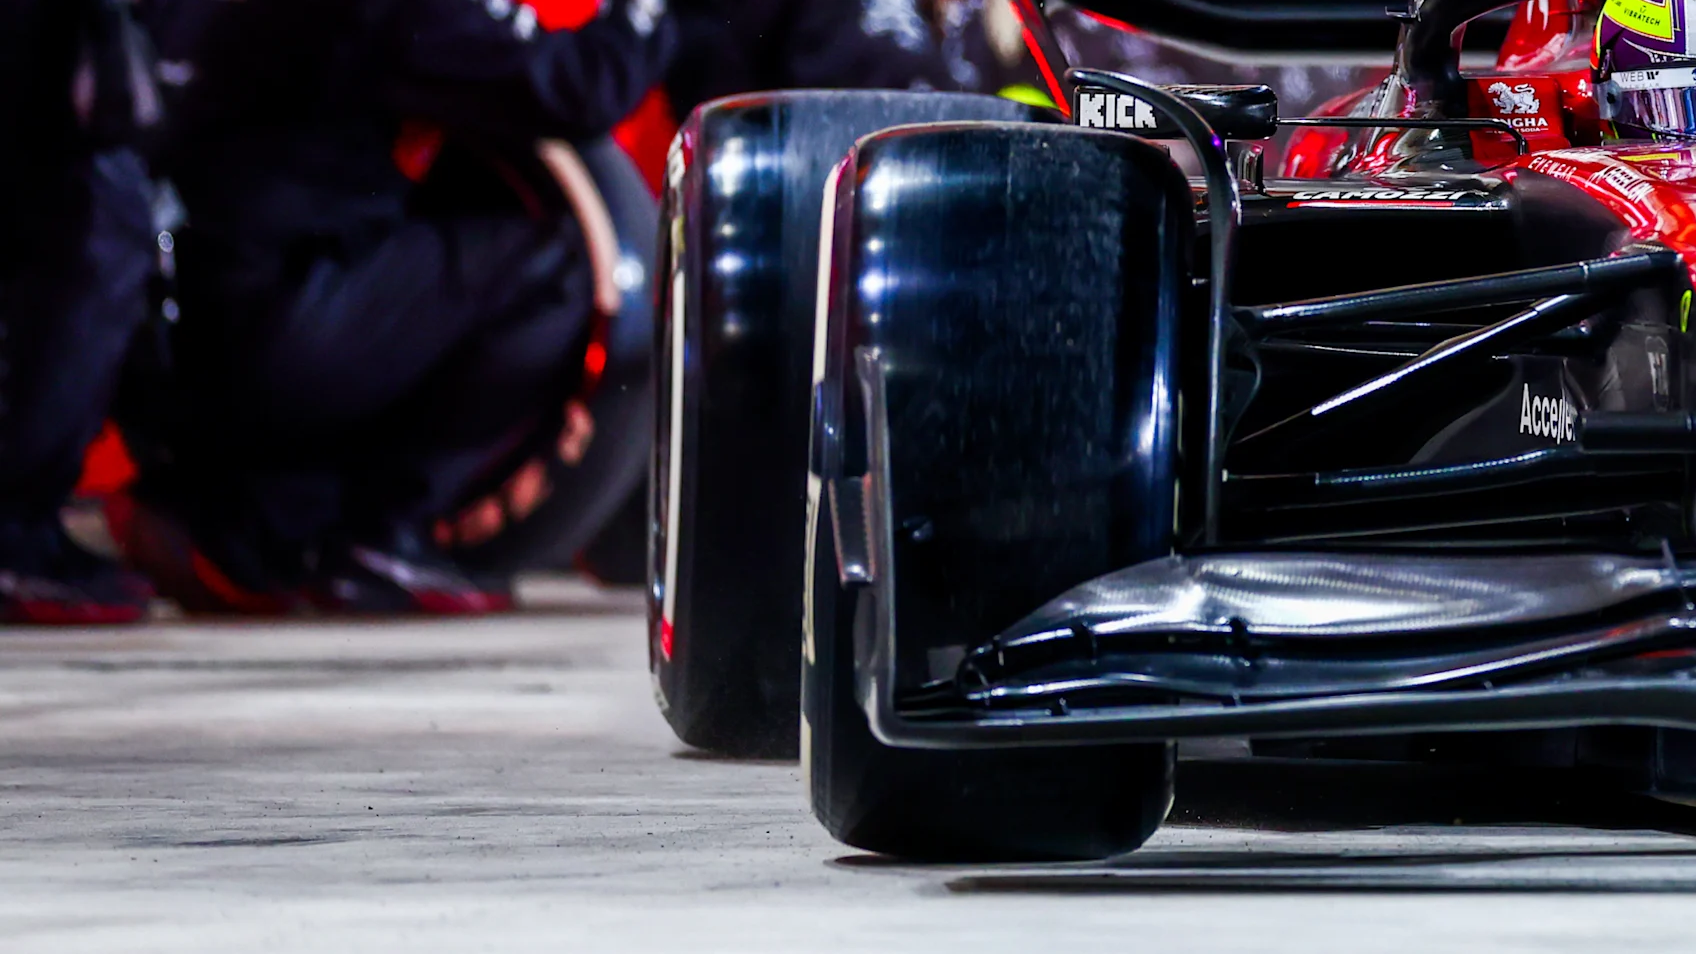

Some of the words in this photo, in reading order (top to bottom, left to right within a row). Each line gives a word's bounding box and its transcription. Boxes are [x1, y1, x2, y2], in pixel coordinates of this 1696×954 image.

[1623, 7, 1661, 26] VIBRATECH
[1620, 71, 1645, 83] WEB
[1079, 93, 1158, 129] KICK
[1293, 190, 1468, 200] CAMOZZI
